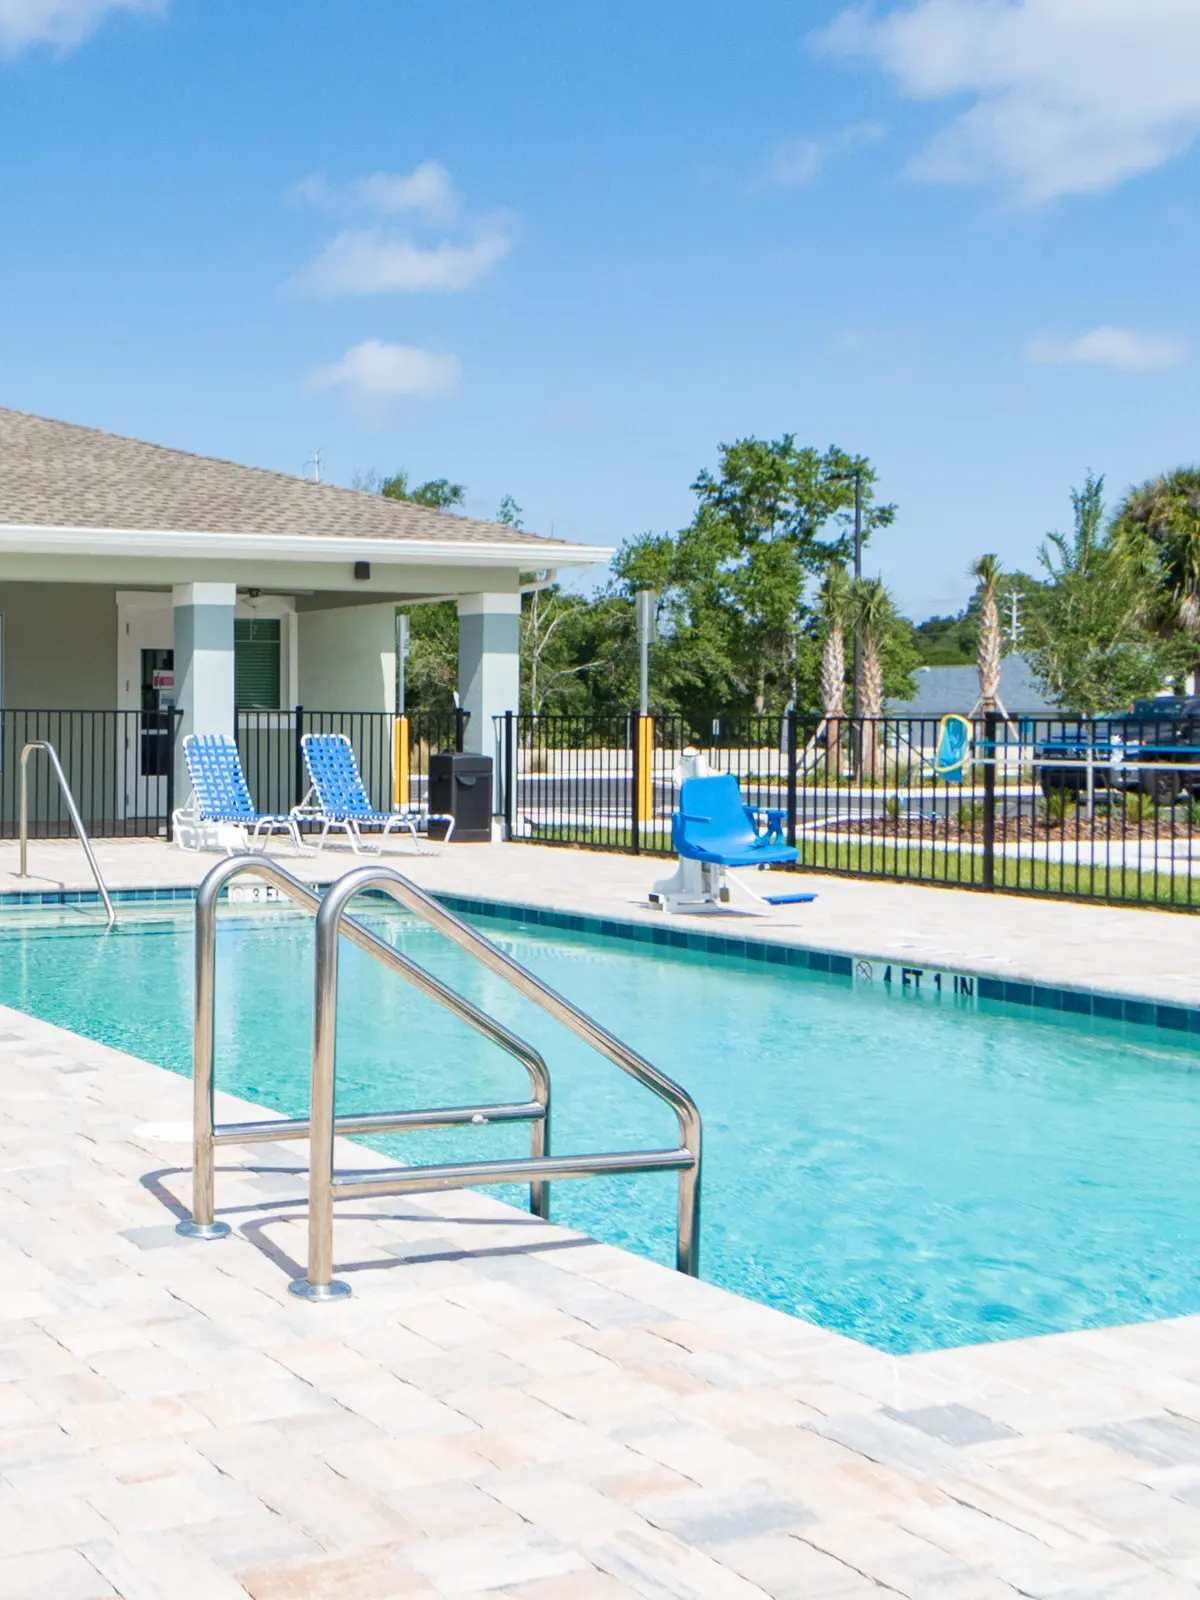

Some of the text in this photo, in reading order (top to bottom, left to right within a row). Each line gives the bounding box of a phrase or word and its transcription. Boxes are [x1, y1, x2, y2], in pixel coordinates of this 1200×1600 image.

[902, 967, 923, 988] FT
[934, 973, 942, 991] 1
[954, 975, 974, 996] IN
